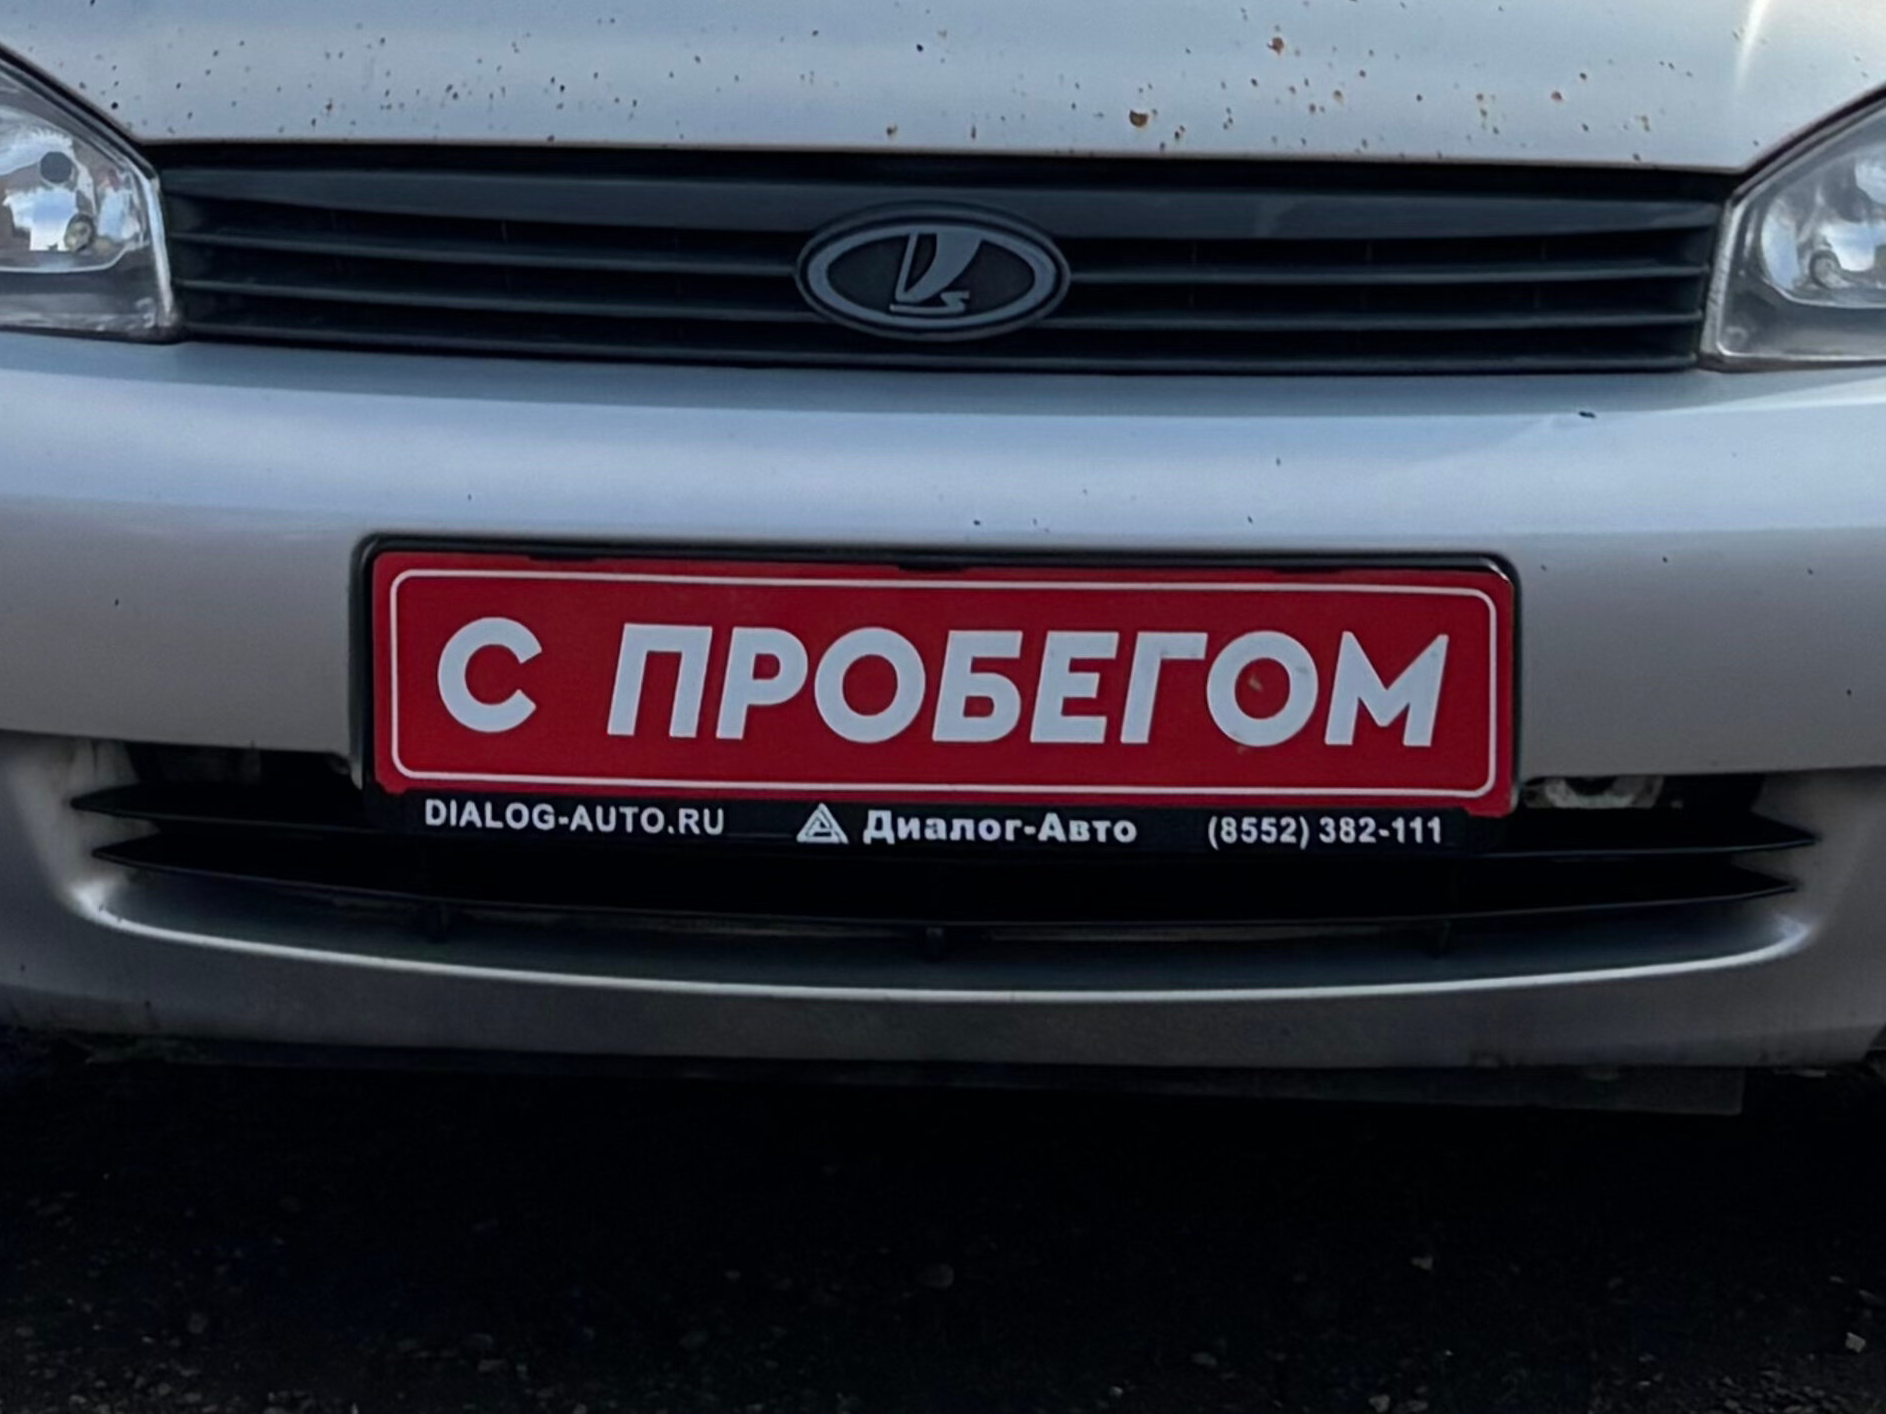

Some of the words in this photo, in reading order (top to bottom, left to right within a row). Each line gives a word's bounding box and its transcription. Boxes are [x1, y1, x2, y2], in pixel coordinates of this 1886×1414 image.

[436, 616, 543, 734] С
[606, 622, 1449, 748] ПРОБЕГОМ
[424, 798, 725, 836] DIALOG-AUTO.RU
[862, 808, 1138, 846] Диалог-Авто
[1207, 815, 1311, 850] (8552)
[1318, 815, 1442, 844] 382-111
